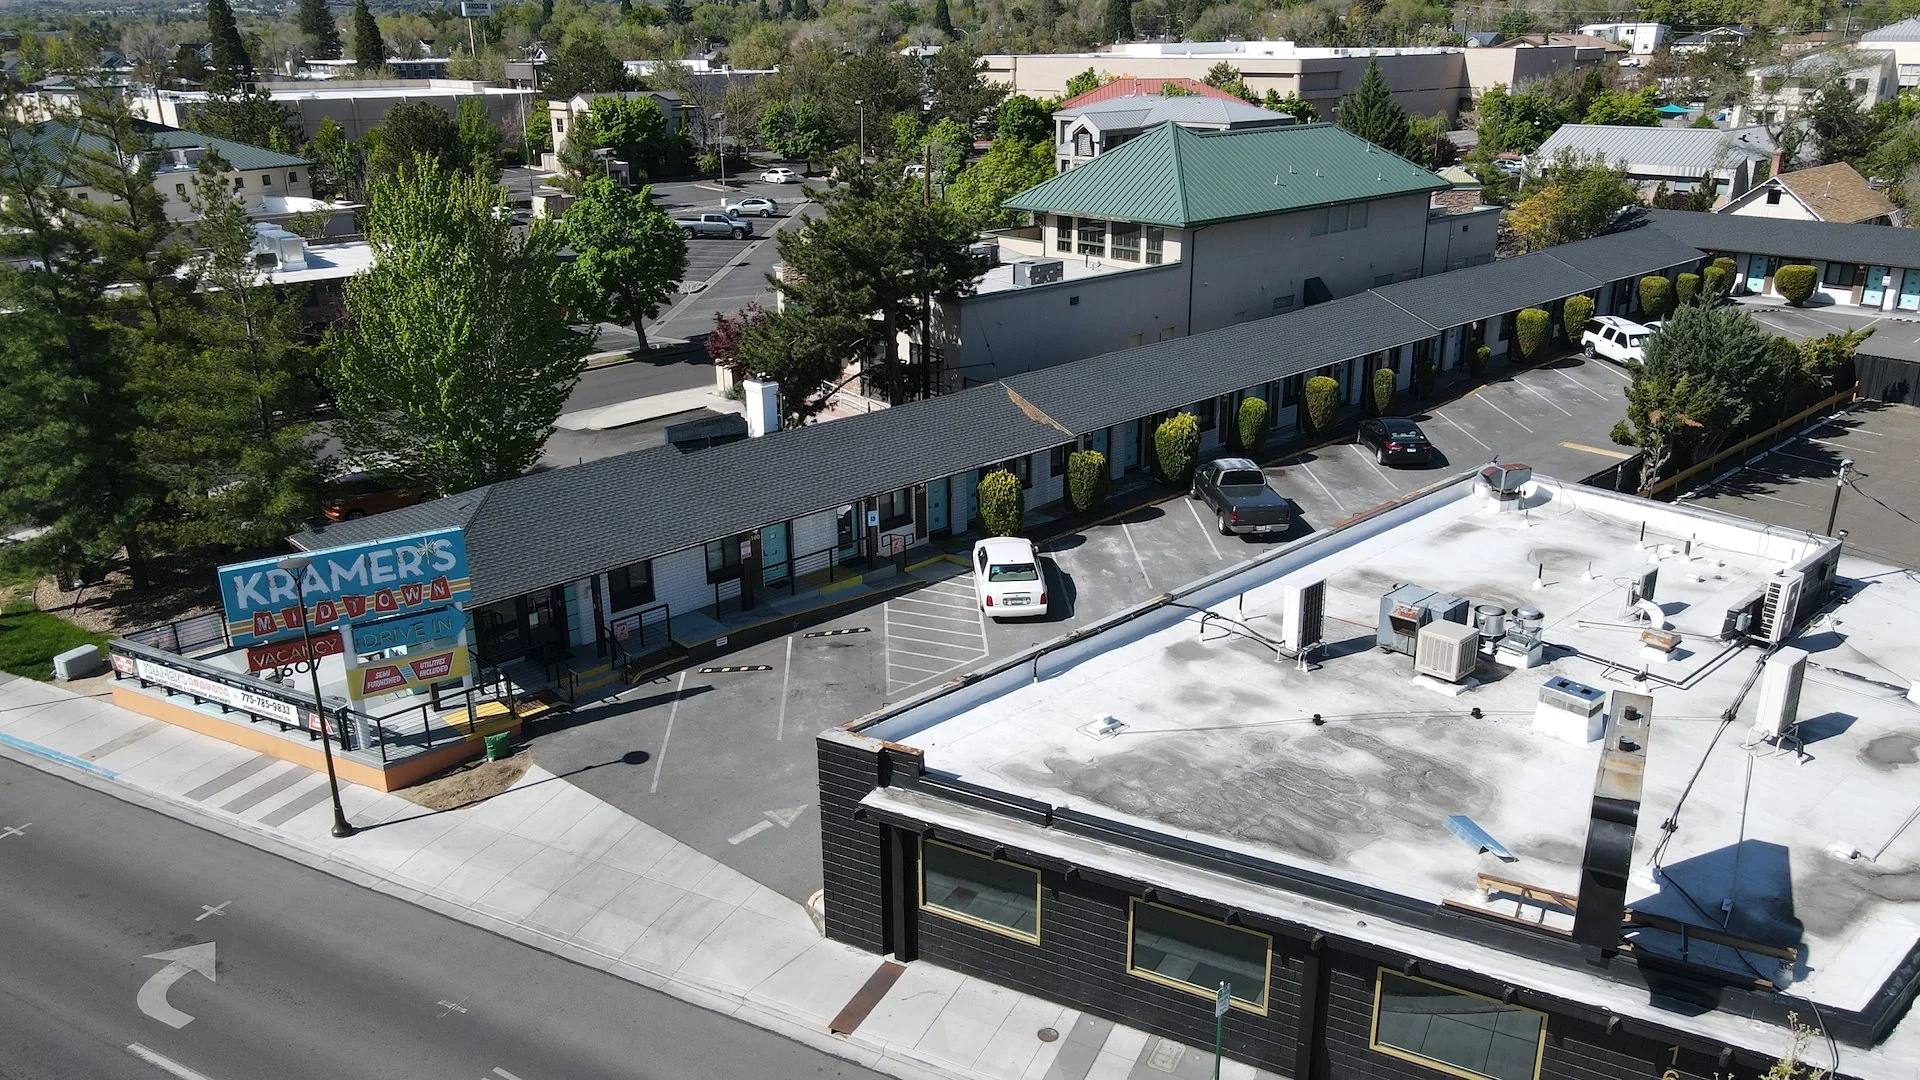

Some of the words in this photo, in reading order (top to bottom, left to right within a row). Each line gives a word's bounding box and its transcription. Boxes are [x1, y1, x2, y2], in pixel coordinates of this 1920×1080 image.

[233, 539, 457, 609] KRAMER'S
[257, 582, 446, 631] MIDTOWN
[363, 622, 426, 648] DRIVE
[433, 617, 453, 633] IN
[253, 639, 337, 667] VACANCY
[420, 657, 447, 670] UTILITIES
[367, 675, 402, 690] FURNISHED
[375, 669, 392, 680] SEMI
[420, 664, 449, 678] INCLUDED
[241, 692, 291, 715] 775-785-9833
